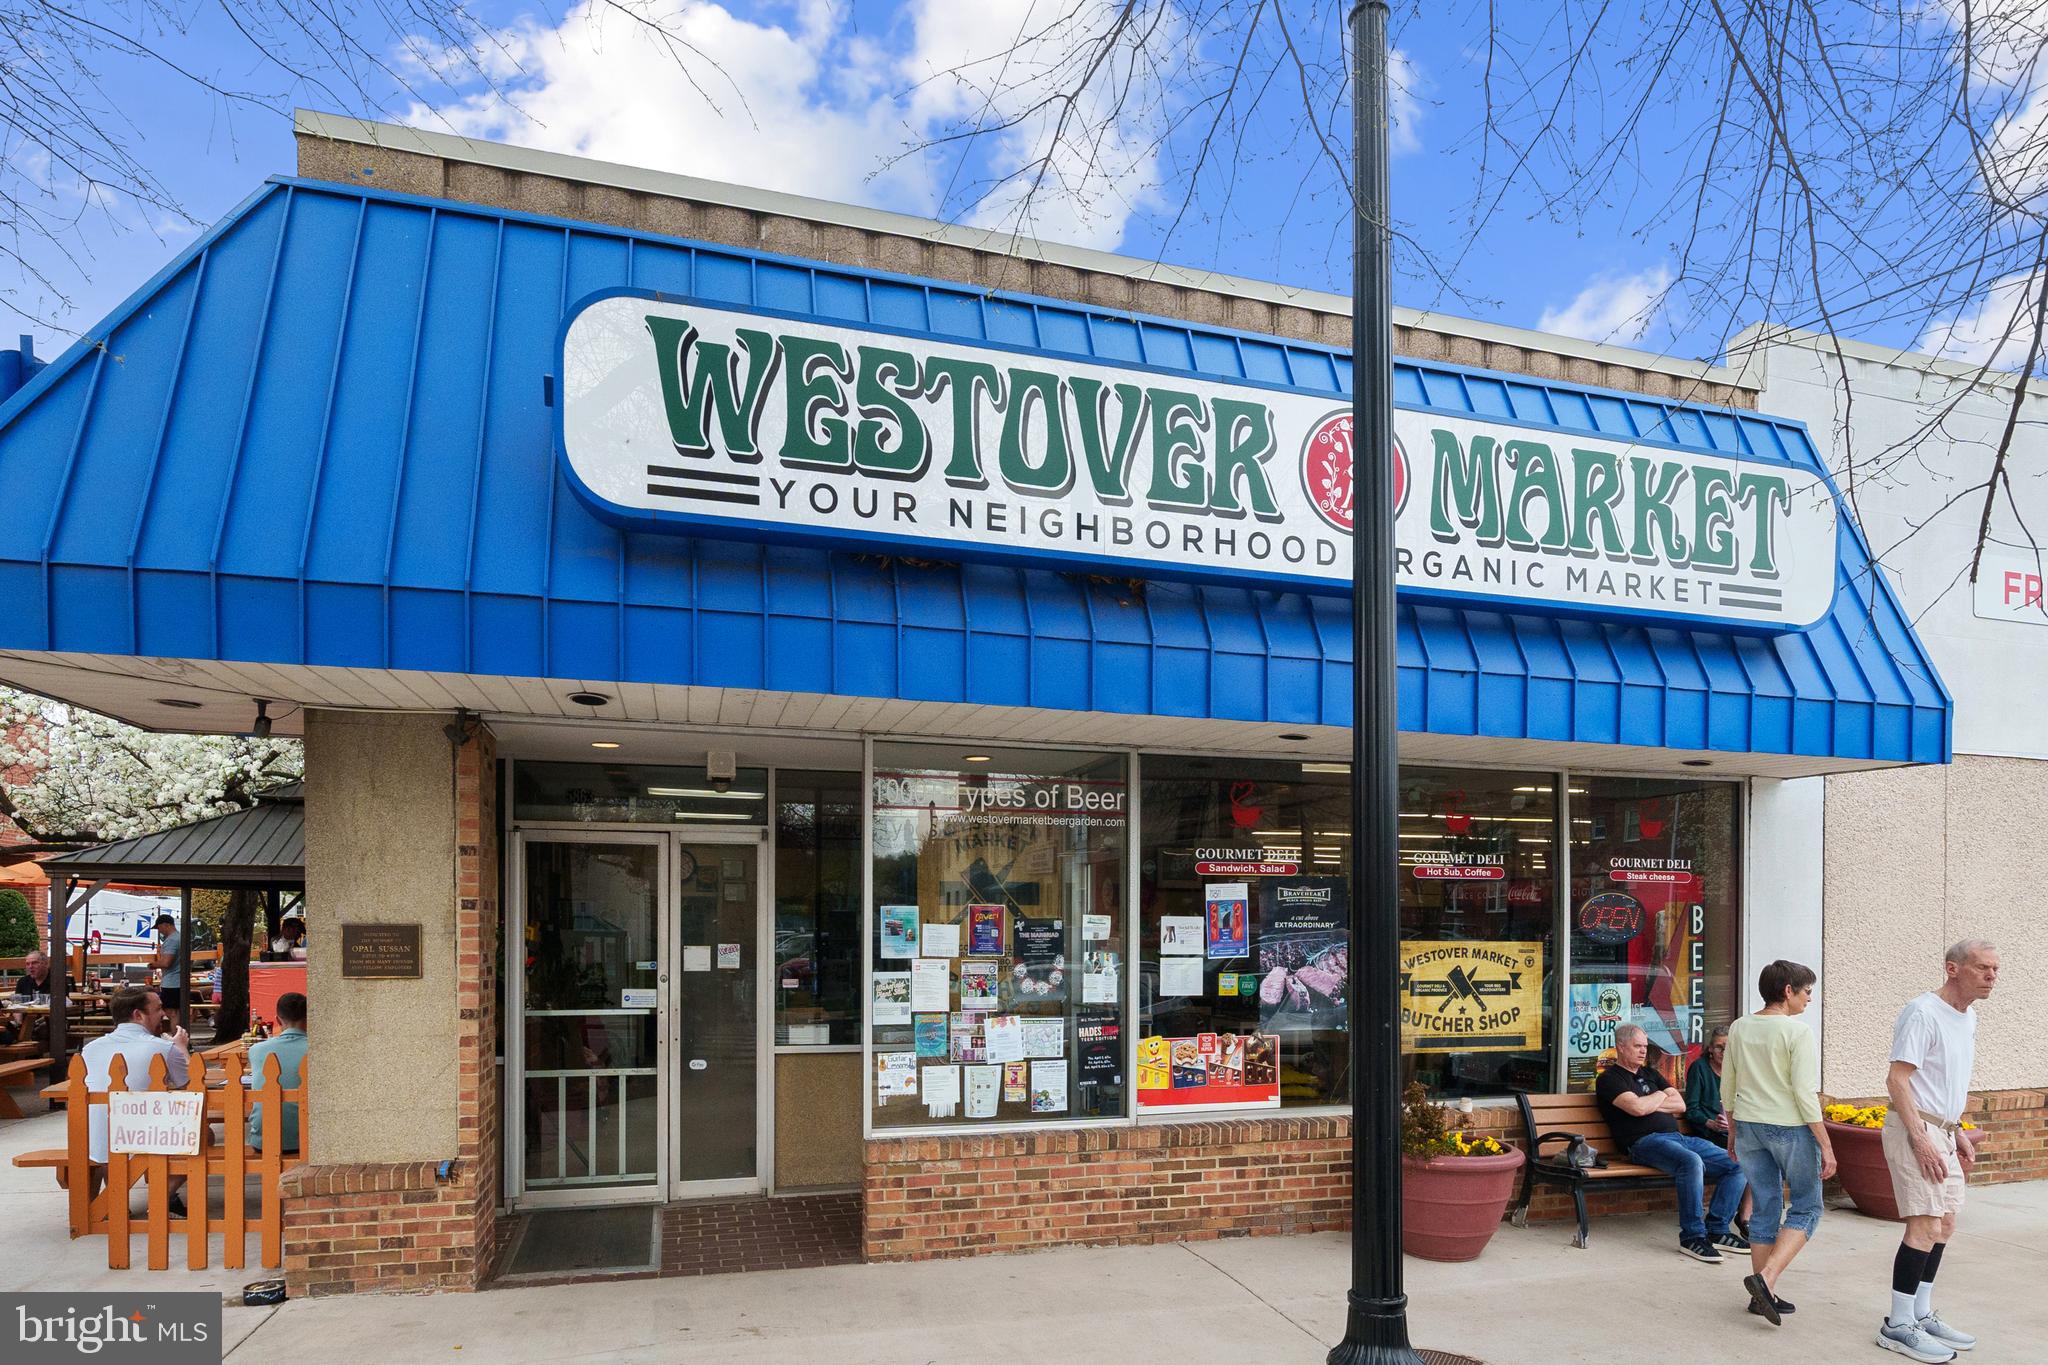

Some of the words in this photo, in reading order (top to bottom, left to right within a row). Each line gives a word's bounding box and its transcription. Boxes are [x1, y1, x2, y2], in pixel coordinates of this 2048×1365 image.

[645, 315, 1285, 524] WESTOVER
[1430, 429, 1792, 580] MARKET
[769, 478, 917, 523] YOUR
[950, 499, 1337, 566] NEIGHBORHOOD
[1396, 549, 1545, 588] RGANIC
[1567, 566, 1713, 605] MARKET
[2004, 571, 2048, 610] FR
[951, 780, 1026, 812] Types
[1035, 784, 1060, 808] of
[1067, 785, 1125, 810] Beer
[941, 813, 1126, 828] www.westovermarketbeergarden.com
[1195, 848, 1263, 860] GOURMET
[1266, 849, 1298, 861] DELI
[1413, 852, 1475, 865] GOURMET
[1477, 854, 1504, 865] DELI
[1610, 857, 1665, 869] GOURMET
[1666, 859, 1691, 870] DELI
[1208, 863, 1257, 873] Sandwich,
[1259, 864, 1286, 873] Salad
[1426, 867, 1442, 876] Hot
[1464, 868, 1492, 877] Coffee
[1626, 872, 1648, 881] Steak
[1648, 873, 1676, 881] cheese
[1274, 921, 1336, 929] EXTRAORDINARY
[1581, 905, 1641, 929] OPEN
[351, 945, 375, 953] OPAL
[1404, 947, 1469, 970] WESTOVER
[1471, 948, 1519, 970] MARKET
[1692, 904, 1704, 1043] BEER
[1401, 1007, 1474, 1032] BUTCHER
[1479, 1006, 1521, 1031] SHOP
[1571, 1013, 1617, 1035] YOUR
[1571, 1032, 1615, 1054] GRIL
[112, 1101, 147, 1116] Food
[152, 1101, 163, 1115] &
[114, 1125, 198, 1147] Available
